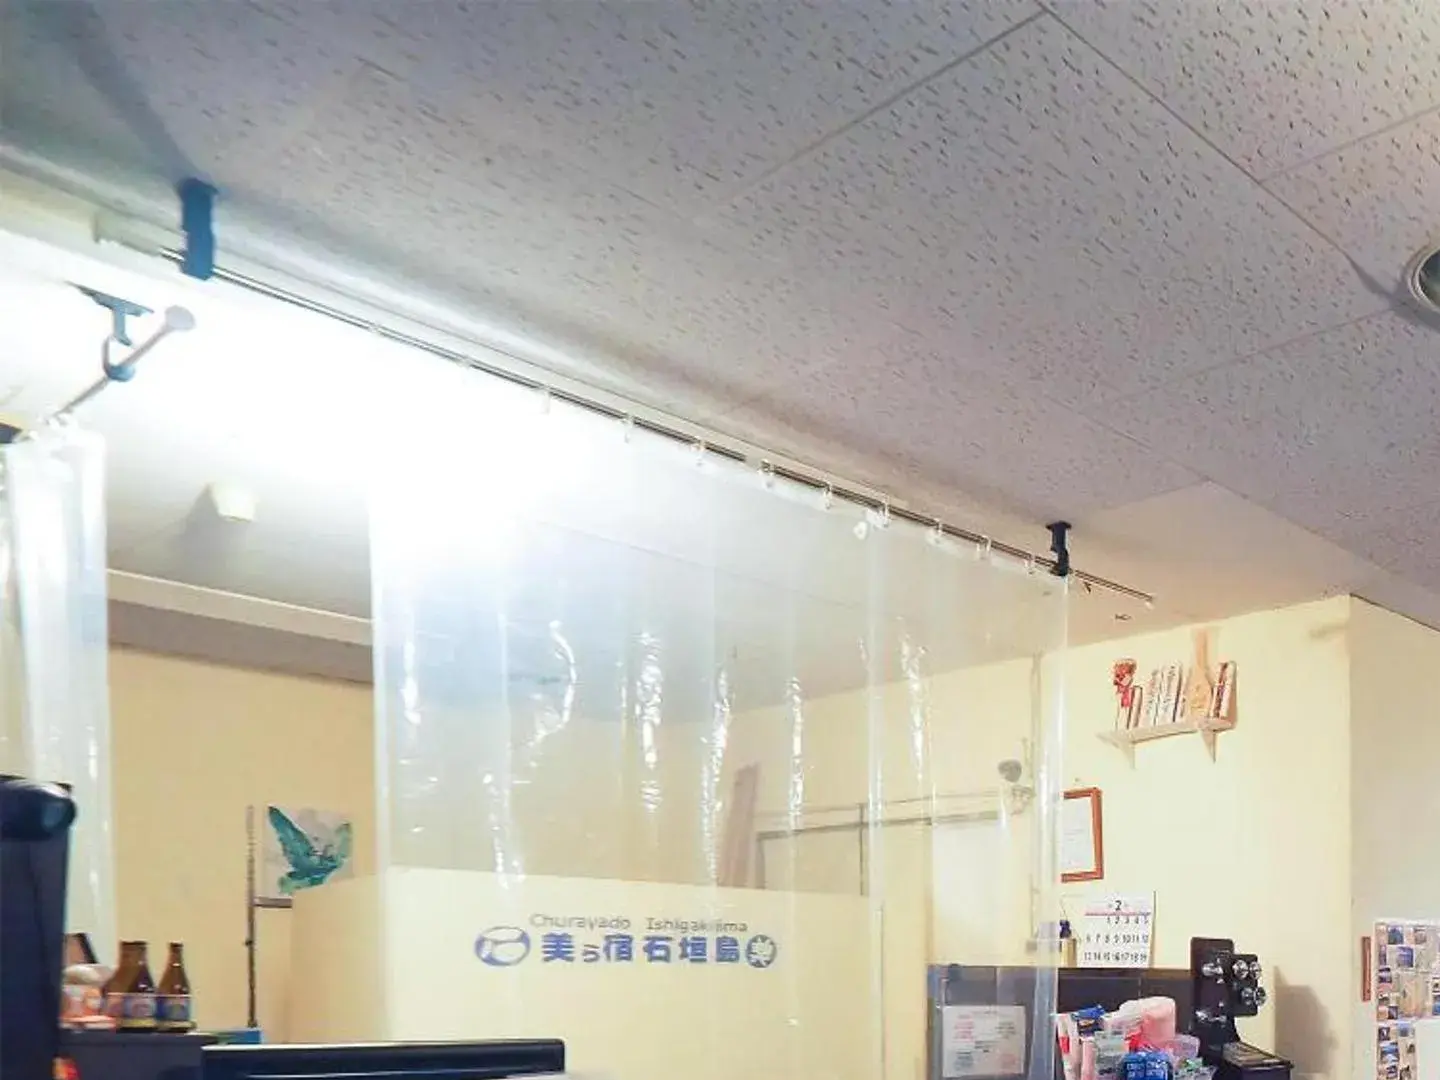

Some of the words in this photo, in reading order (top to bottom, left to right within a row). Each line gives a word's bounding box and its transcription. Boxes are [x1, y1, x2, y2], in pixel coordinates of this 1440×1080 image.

[529, 913, 632, 931] Churayado
[541, 932, 740, 963] 美ら宿石垣島
